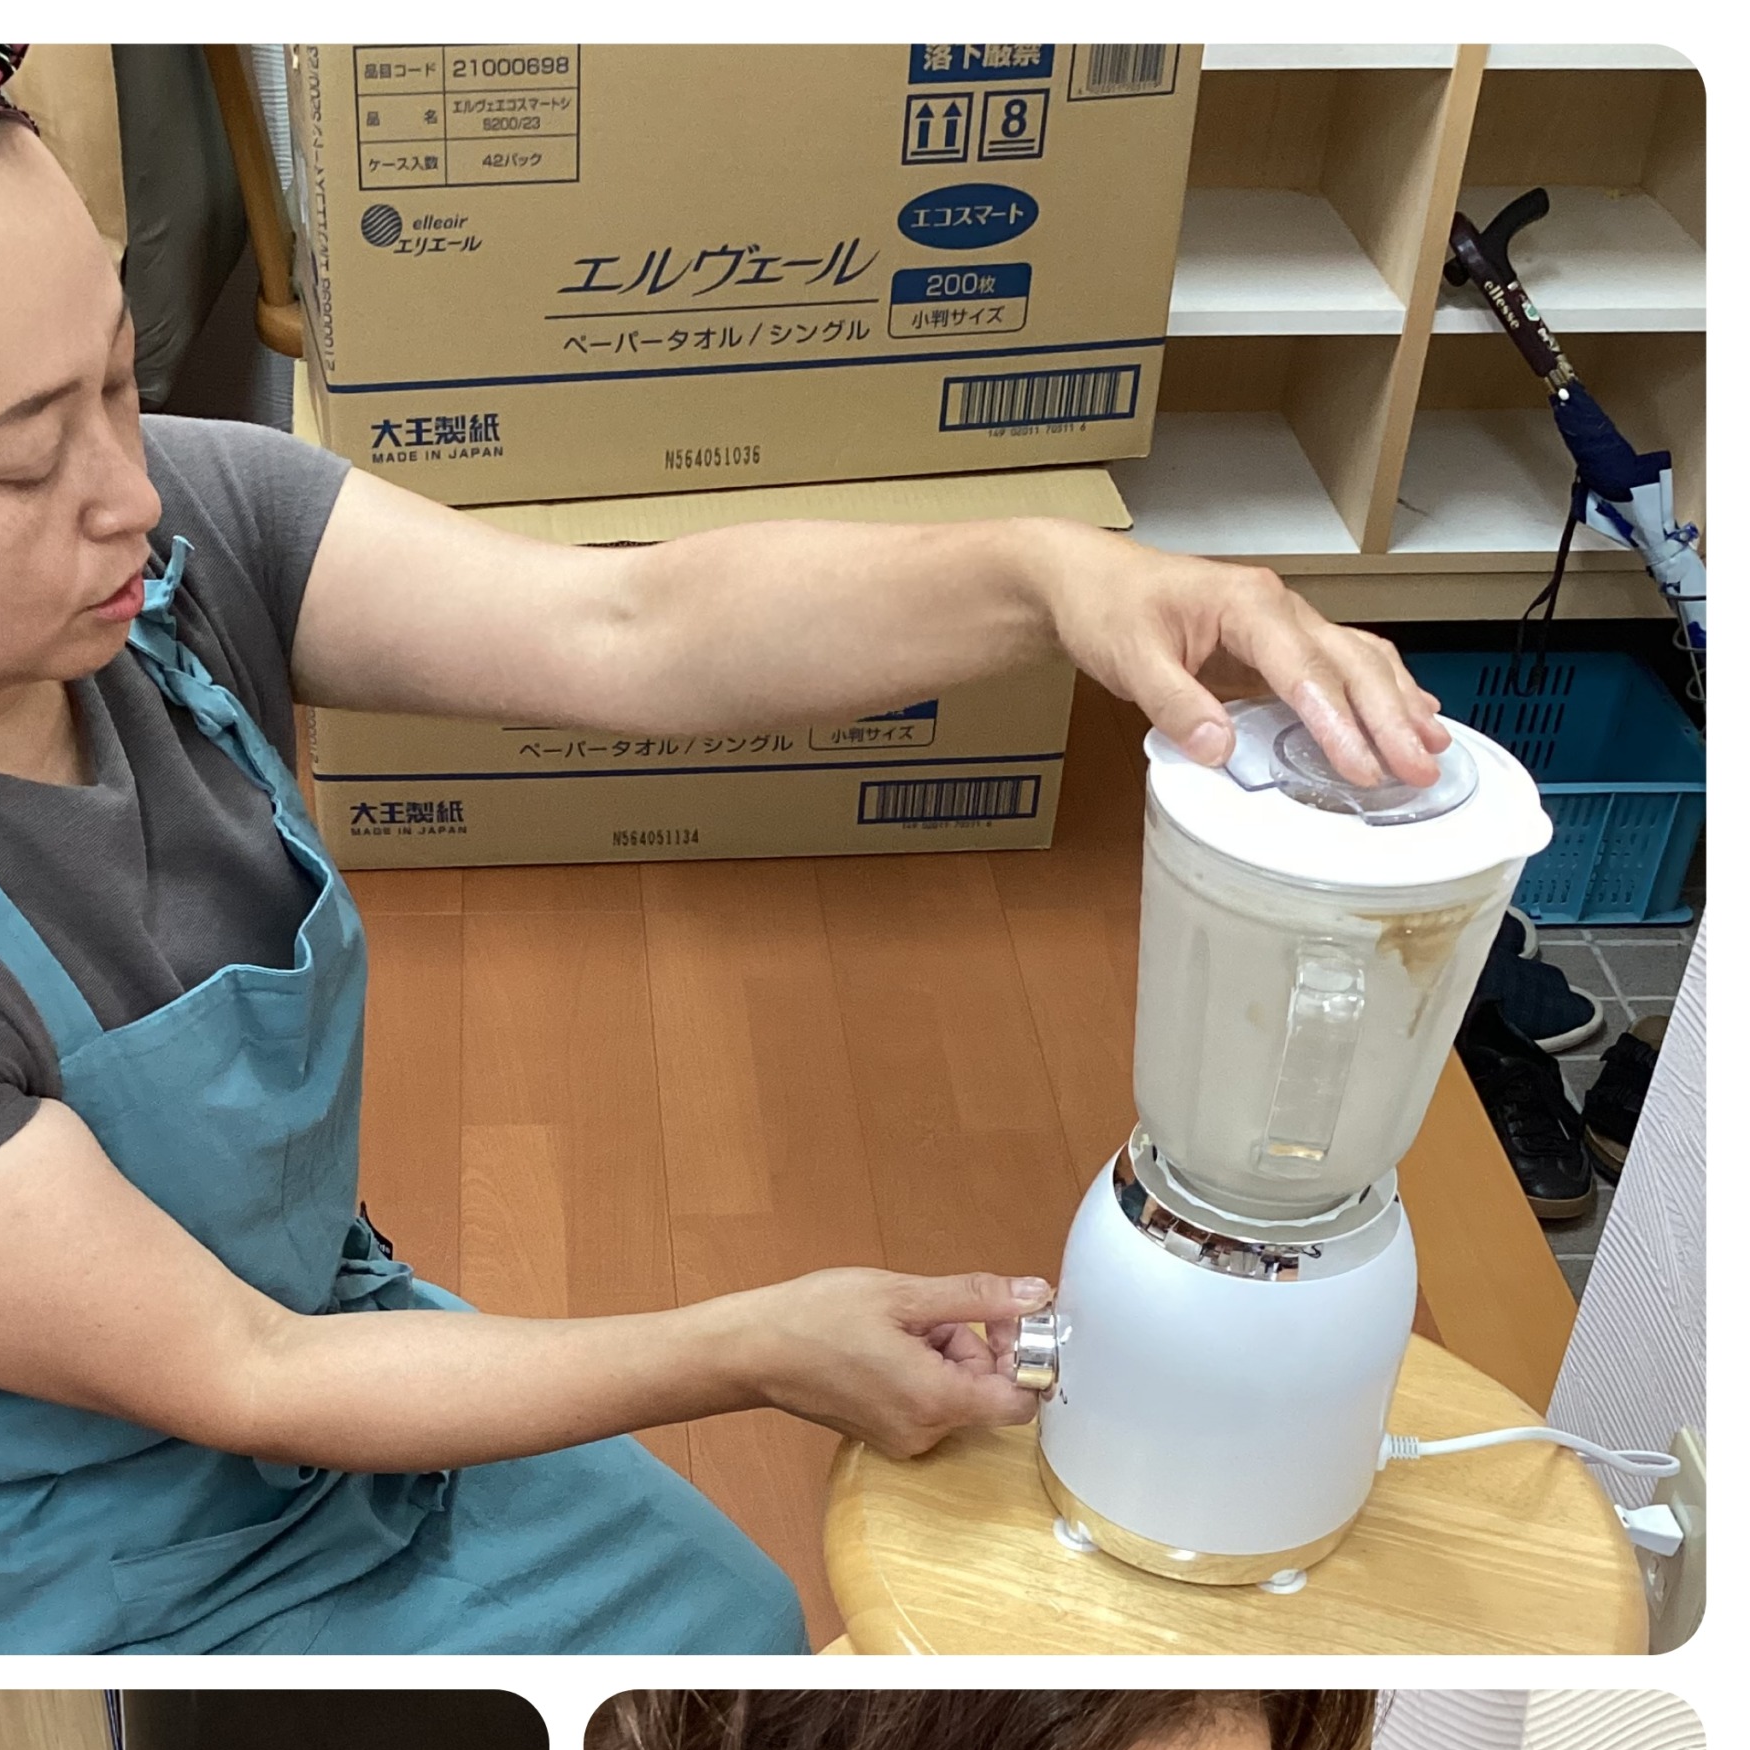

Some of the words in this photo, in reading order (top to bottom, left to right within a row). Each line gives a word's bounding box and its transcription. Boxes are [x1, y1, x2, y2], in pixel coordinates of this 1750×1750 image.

[364, 62, 436, 79] 品目コード
[452, 56, 570, 78] 21000698
[1001, 98, 1027, 138] 8
[368, 156, 439, 172] ケース入数
[482, 153, 542, 168] 42パック
[413, 213, 469, 231] elleair
[910, 203, 1025, 231] エコスマート
[393, 235, 483, 257] エリエール
[557, 237, 882, 298] エルヴェール
[925, 272, 996, 299] 200枚
[1484, 281, 1520, 329] ellesse
[912, 305, 1006, 332] 小判サイズ
[371, 412, 501, 449] 大王製紙
[372, 451, 418, 465] MADE
[425, 449, 441, 462] IN
[448, 446, 504, 460] JAPAN
[665, 445, 761, 471] N564051036
[832, 724, 915, 744] 小判サイズ
[350, 799, 465, 825] 大王製紙
[351, 827, 391, 836] MADE
[398, 826, 412, 836] IN
[417, 825, 468, 836] JAPAN
[612, 829, 699, 847] N564051134
